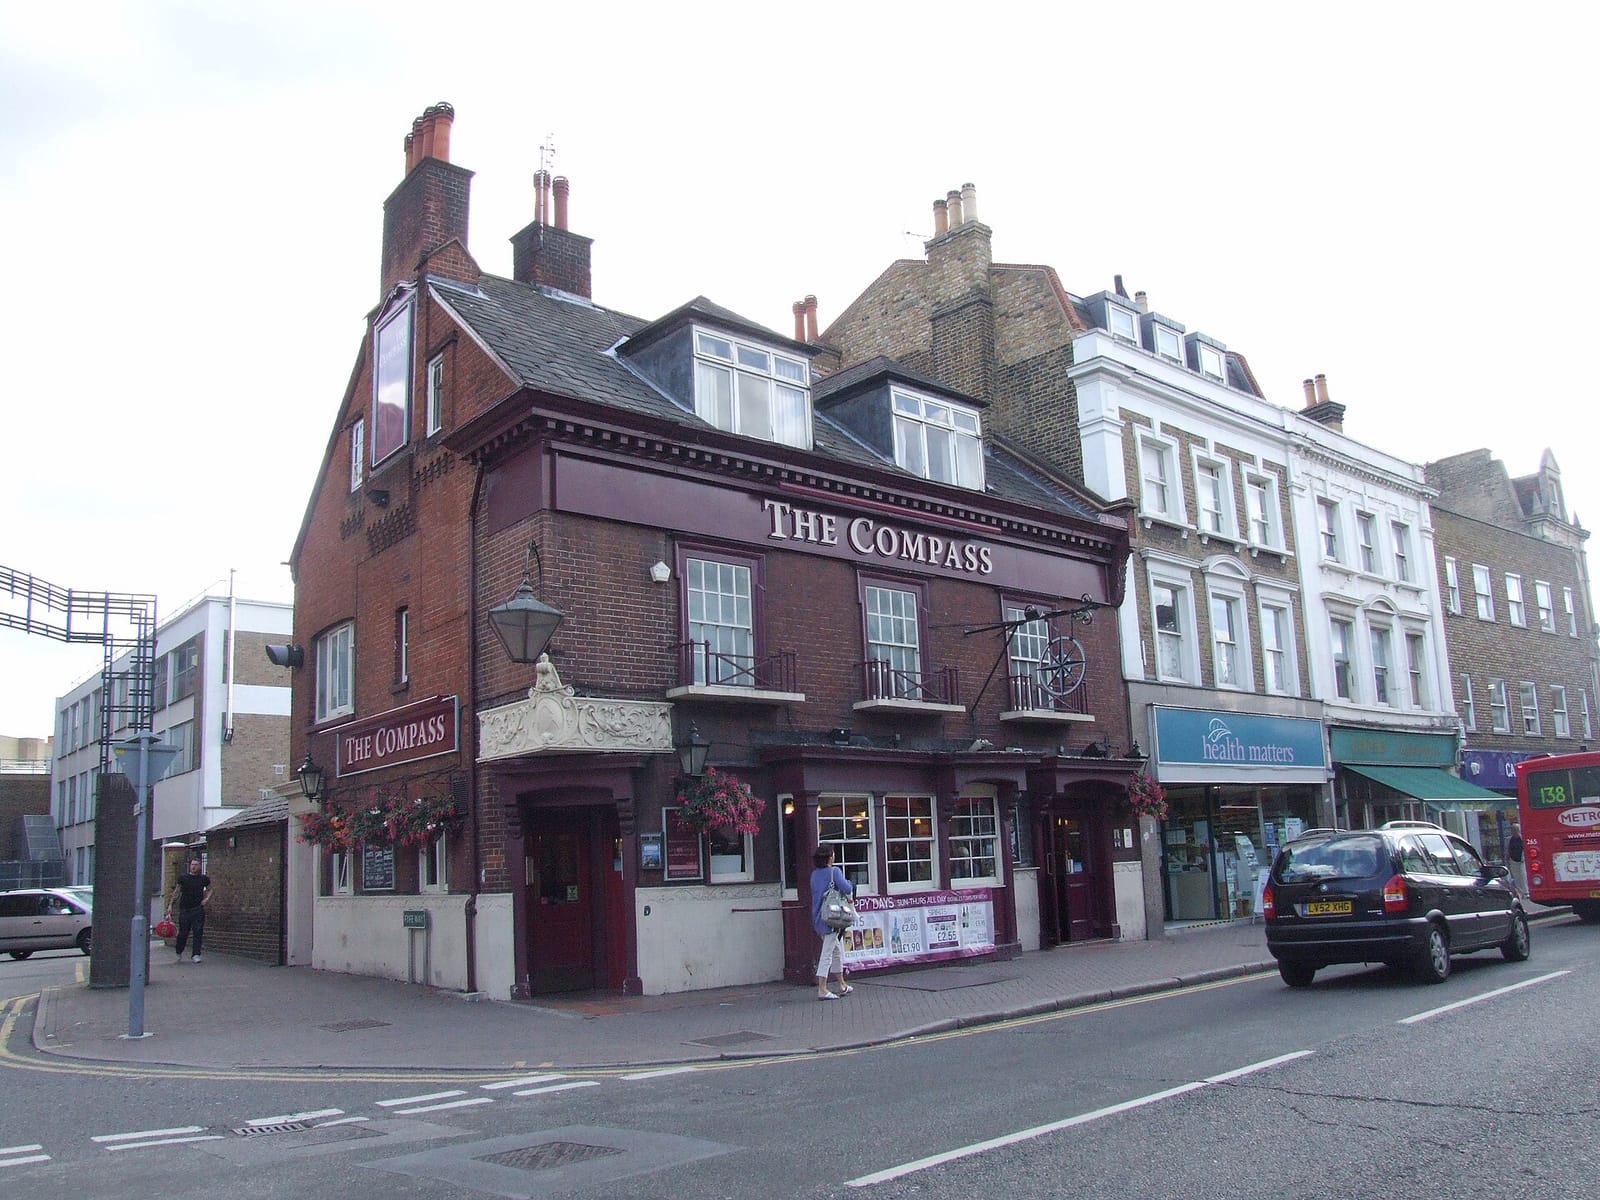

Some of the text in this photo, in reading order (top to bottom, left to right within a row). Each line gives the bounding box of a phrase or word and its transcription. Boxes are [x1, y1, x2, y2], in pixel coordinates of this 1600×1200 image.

[764, 499, 993, 575] THE COMPASS
[346, 714, 445, 765] THE COMPASS
[1202, 735, 1295, 762] health matters
[1505, 763, 1517, 777] CA
[1540, 786, 1566, 804] 138
[872, 896, 895, 909] DAYS
[927, 895, 937, 904] ALL
[1308, 902, 1349, 912] LV52 XHG
[937, 931, 957, 941] £2.55
[902, 943, 921, 953] £1.90
